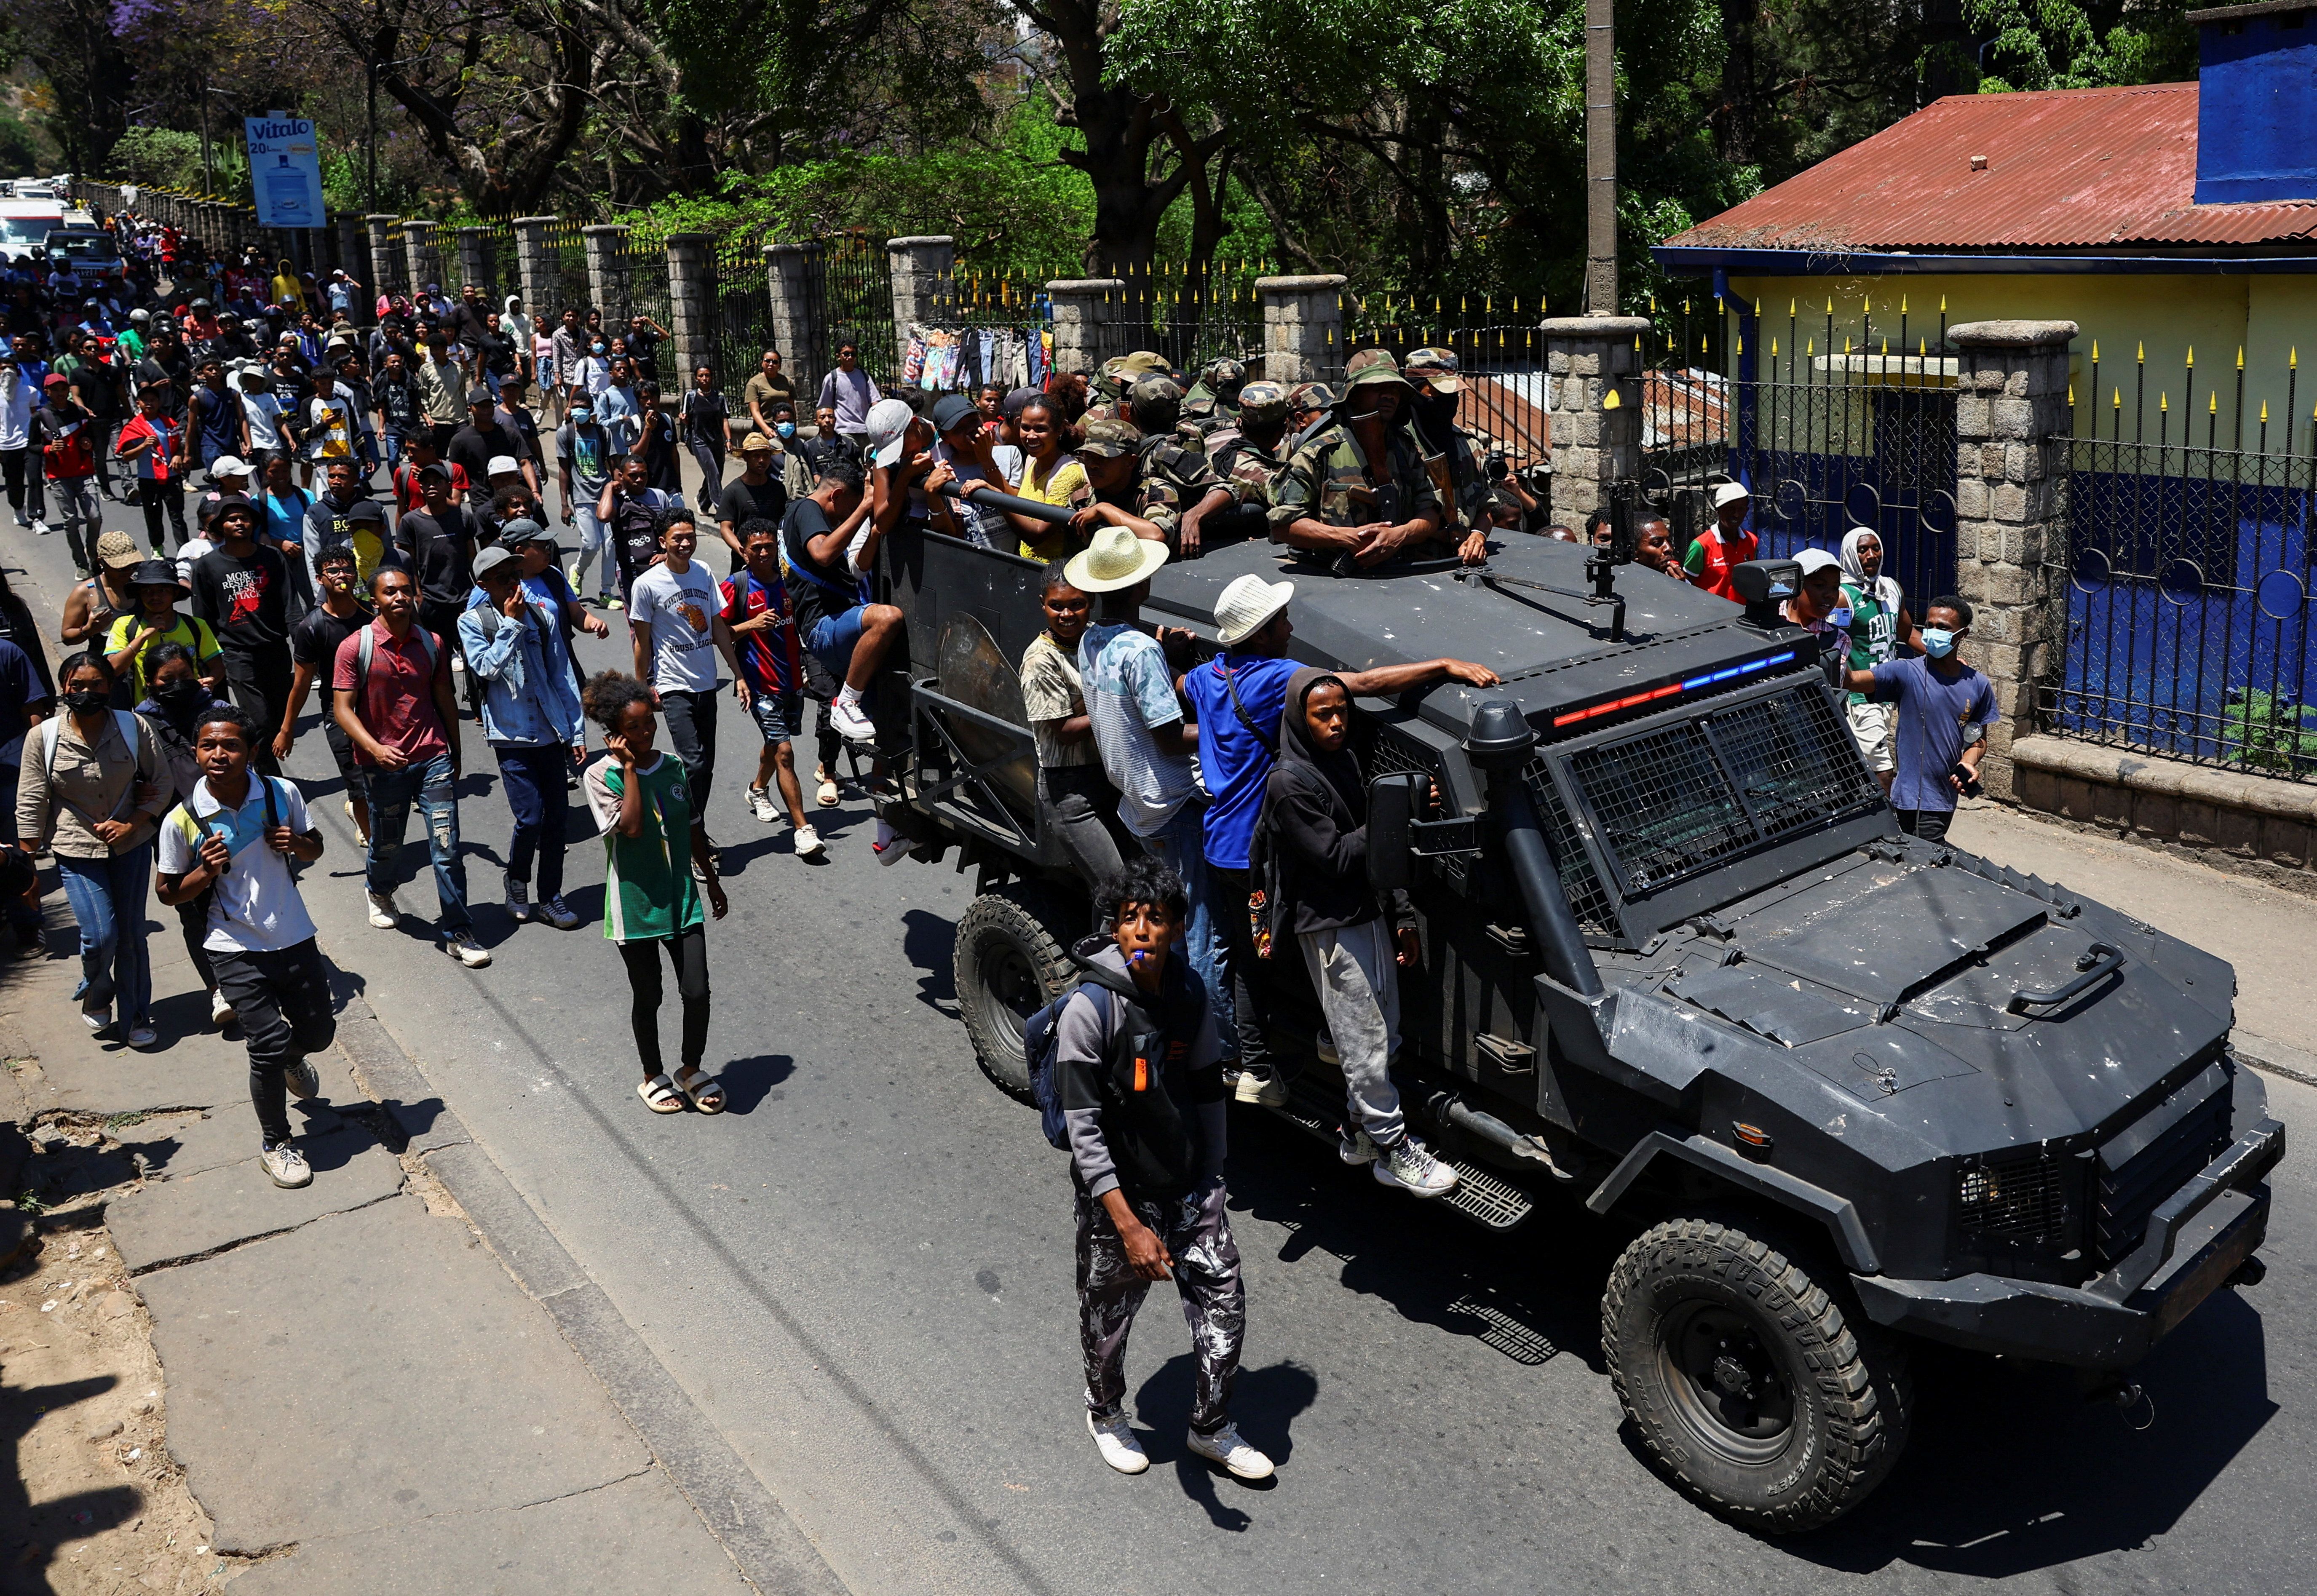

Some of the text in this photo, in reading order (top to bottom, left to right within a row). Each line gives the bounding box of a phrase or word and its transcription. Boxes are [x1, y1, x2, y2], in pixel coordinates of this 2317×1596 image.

[253, 120, 309, 139] Vitalo
[250, 143, 266, 154] 20
[226, 570, 255, 582] MORE
[222, 577, 263, 590] RESPECT
[232, 583, 255, 594] LESS
[228, 590, 262, 602] ATTACK
[683, 588, 694, 599] PARK
[670, 638, 712, 653] HOUSE LEAGU
[1651, 1274, 1737, 1296] COOPER
[1634, 1376, 1690, 1462] STT PRO
